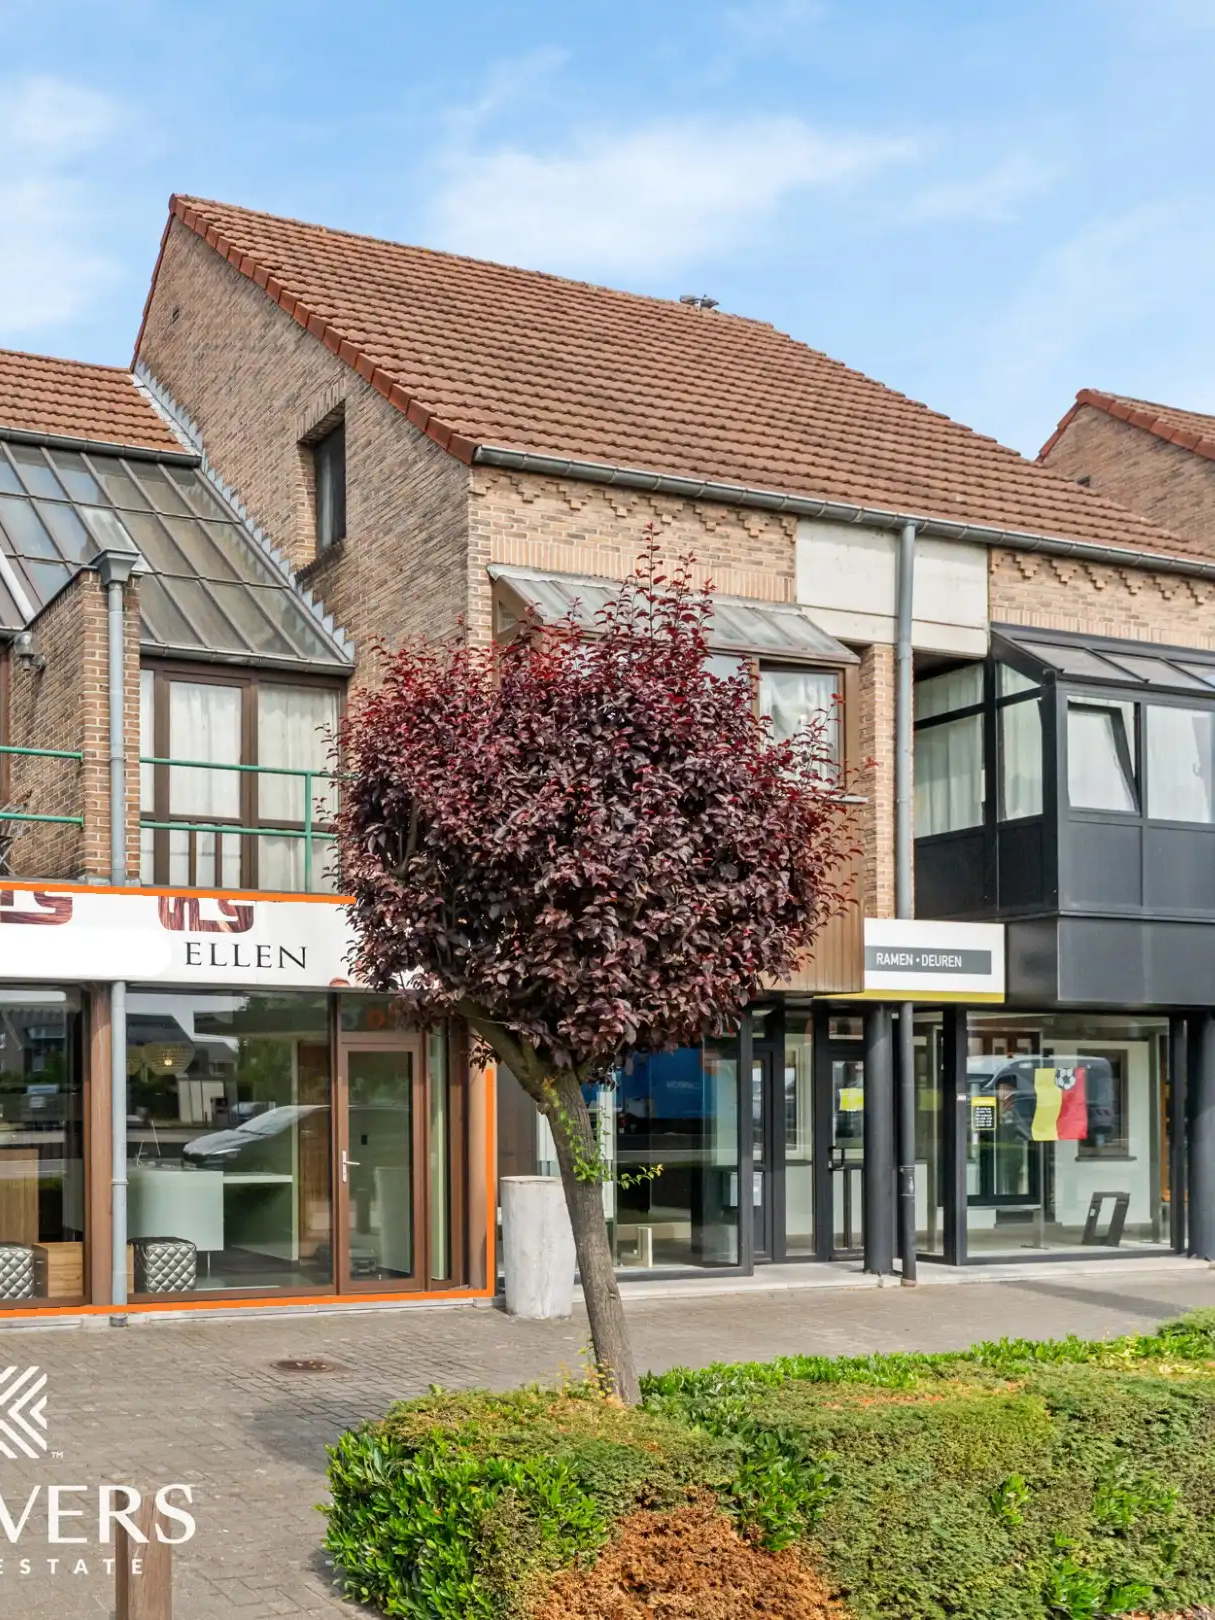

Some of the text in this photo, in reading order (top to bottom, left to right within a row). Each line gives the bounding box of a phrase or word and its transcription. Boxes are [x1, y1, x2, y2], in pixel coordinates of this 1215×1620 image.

[184, 941, 306, 969] ELLEN
[876, 952, 962, 968] RAMEN DEUREN
